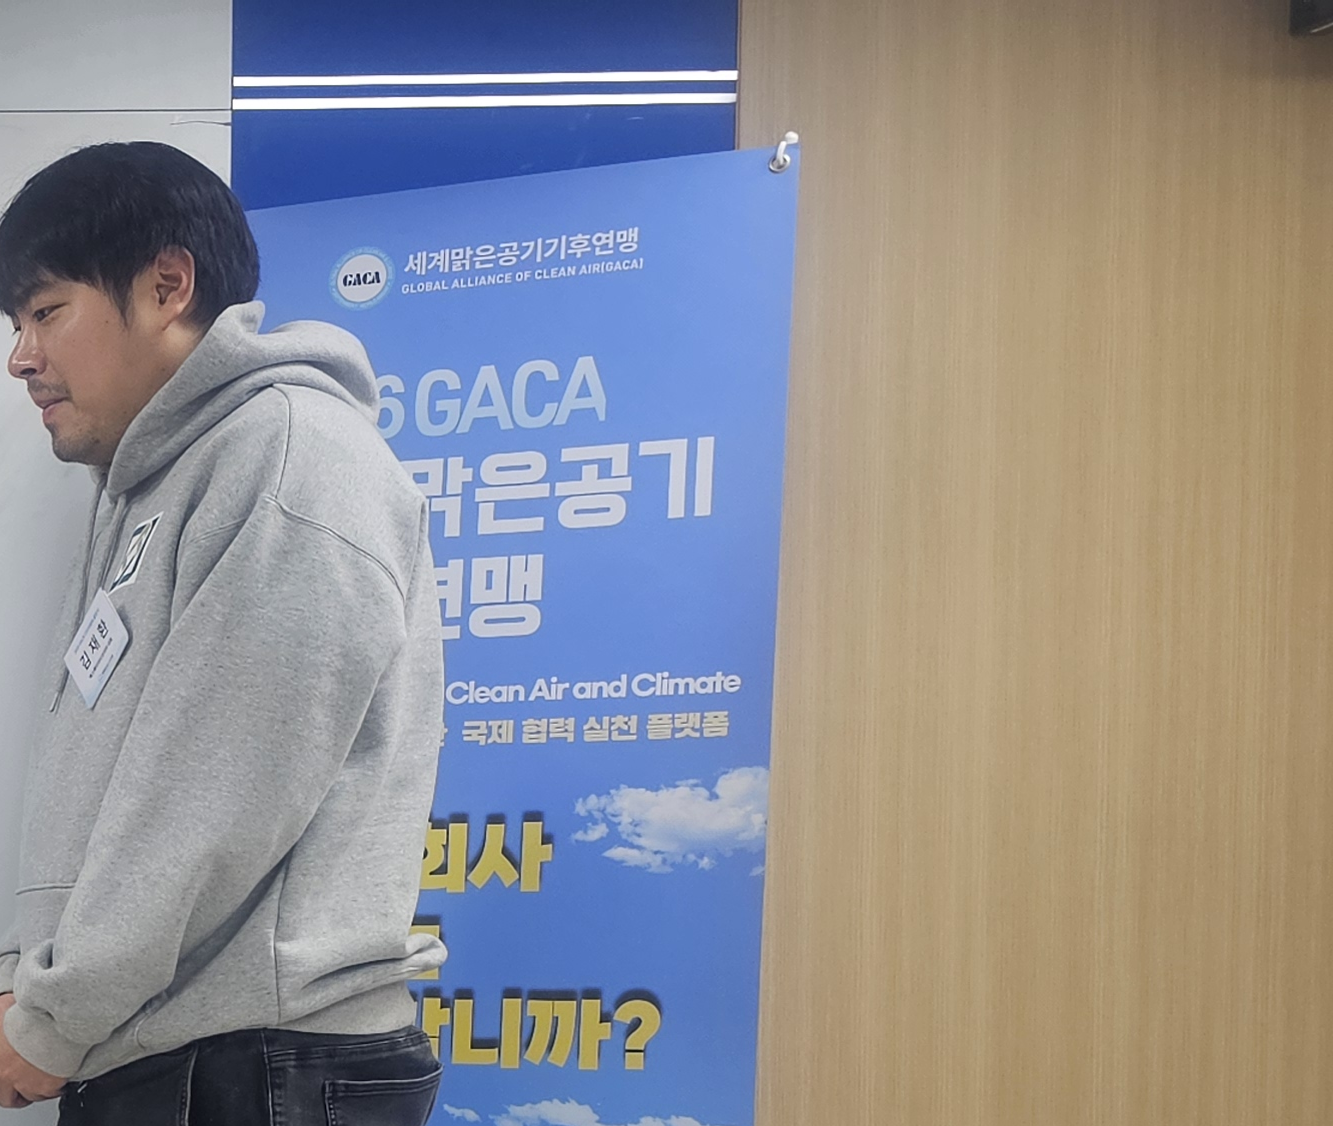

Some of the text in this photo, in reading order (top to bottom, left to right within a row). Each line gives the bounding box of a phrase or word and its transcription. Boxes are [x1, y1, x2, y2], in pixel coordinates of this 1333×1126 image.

[403, 227, 640, 276] 세계맑은공기기후연맹
[342, 270, 381, 288] GACA
[401, 279, 449, 295] GLOBAL
[451, 272, 513, 290] ALLIANCE
[515, 270, 532, 283] OF
[534, 265, 576, 281] CLEAN
[415, 356, 607, 437] GACA
[445, 670, 742, 705] Clean Air and Climate
[462, 719, 514, 746] 국제
[521, 717, 576, 744] 협력
[582, 714, 638, 743] 실천
[646, 710, 730, 741] 플랫폼
